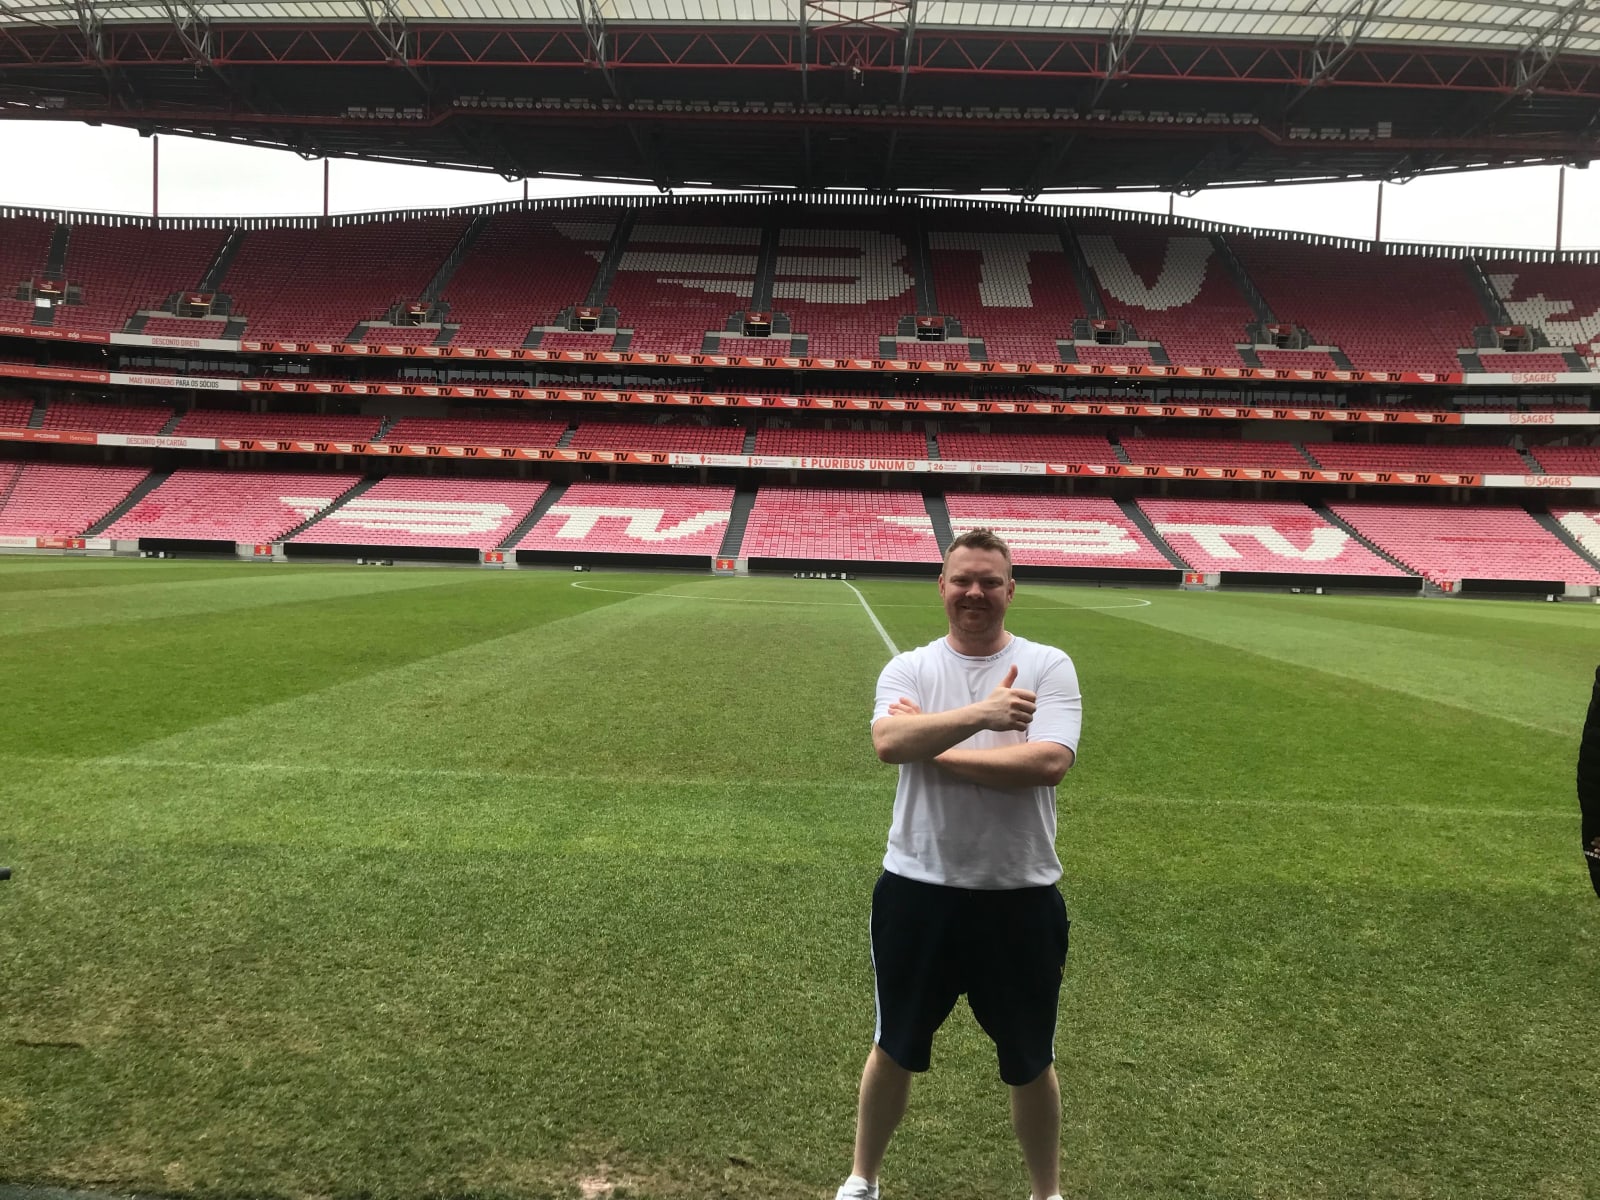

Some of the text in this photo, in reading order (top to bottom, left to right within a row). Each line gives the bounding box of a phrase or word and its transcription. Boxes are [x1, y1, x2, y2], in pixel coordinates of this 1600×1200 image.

[1523, 373, 1557, 383] SAGRES
[175, 379, 190, 387] PARA
[1520, 414, 1555, 424] SAGRES
[706, 456, 712, 465] 2
[753, 458, 763, 466] 37
[801, 458, 905, 471] E PLURIBUS UNUM
[933, 463, 944, 471] 26
[1536, 476, 1571, 486] SAGRES
